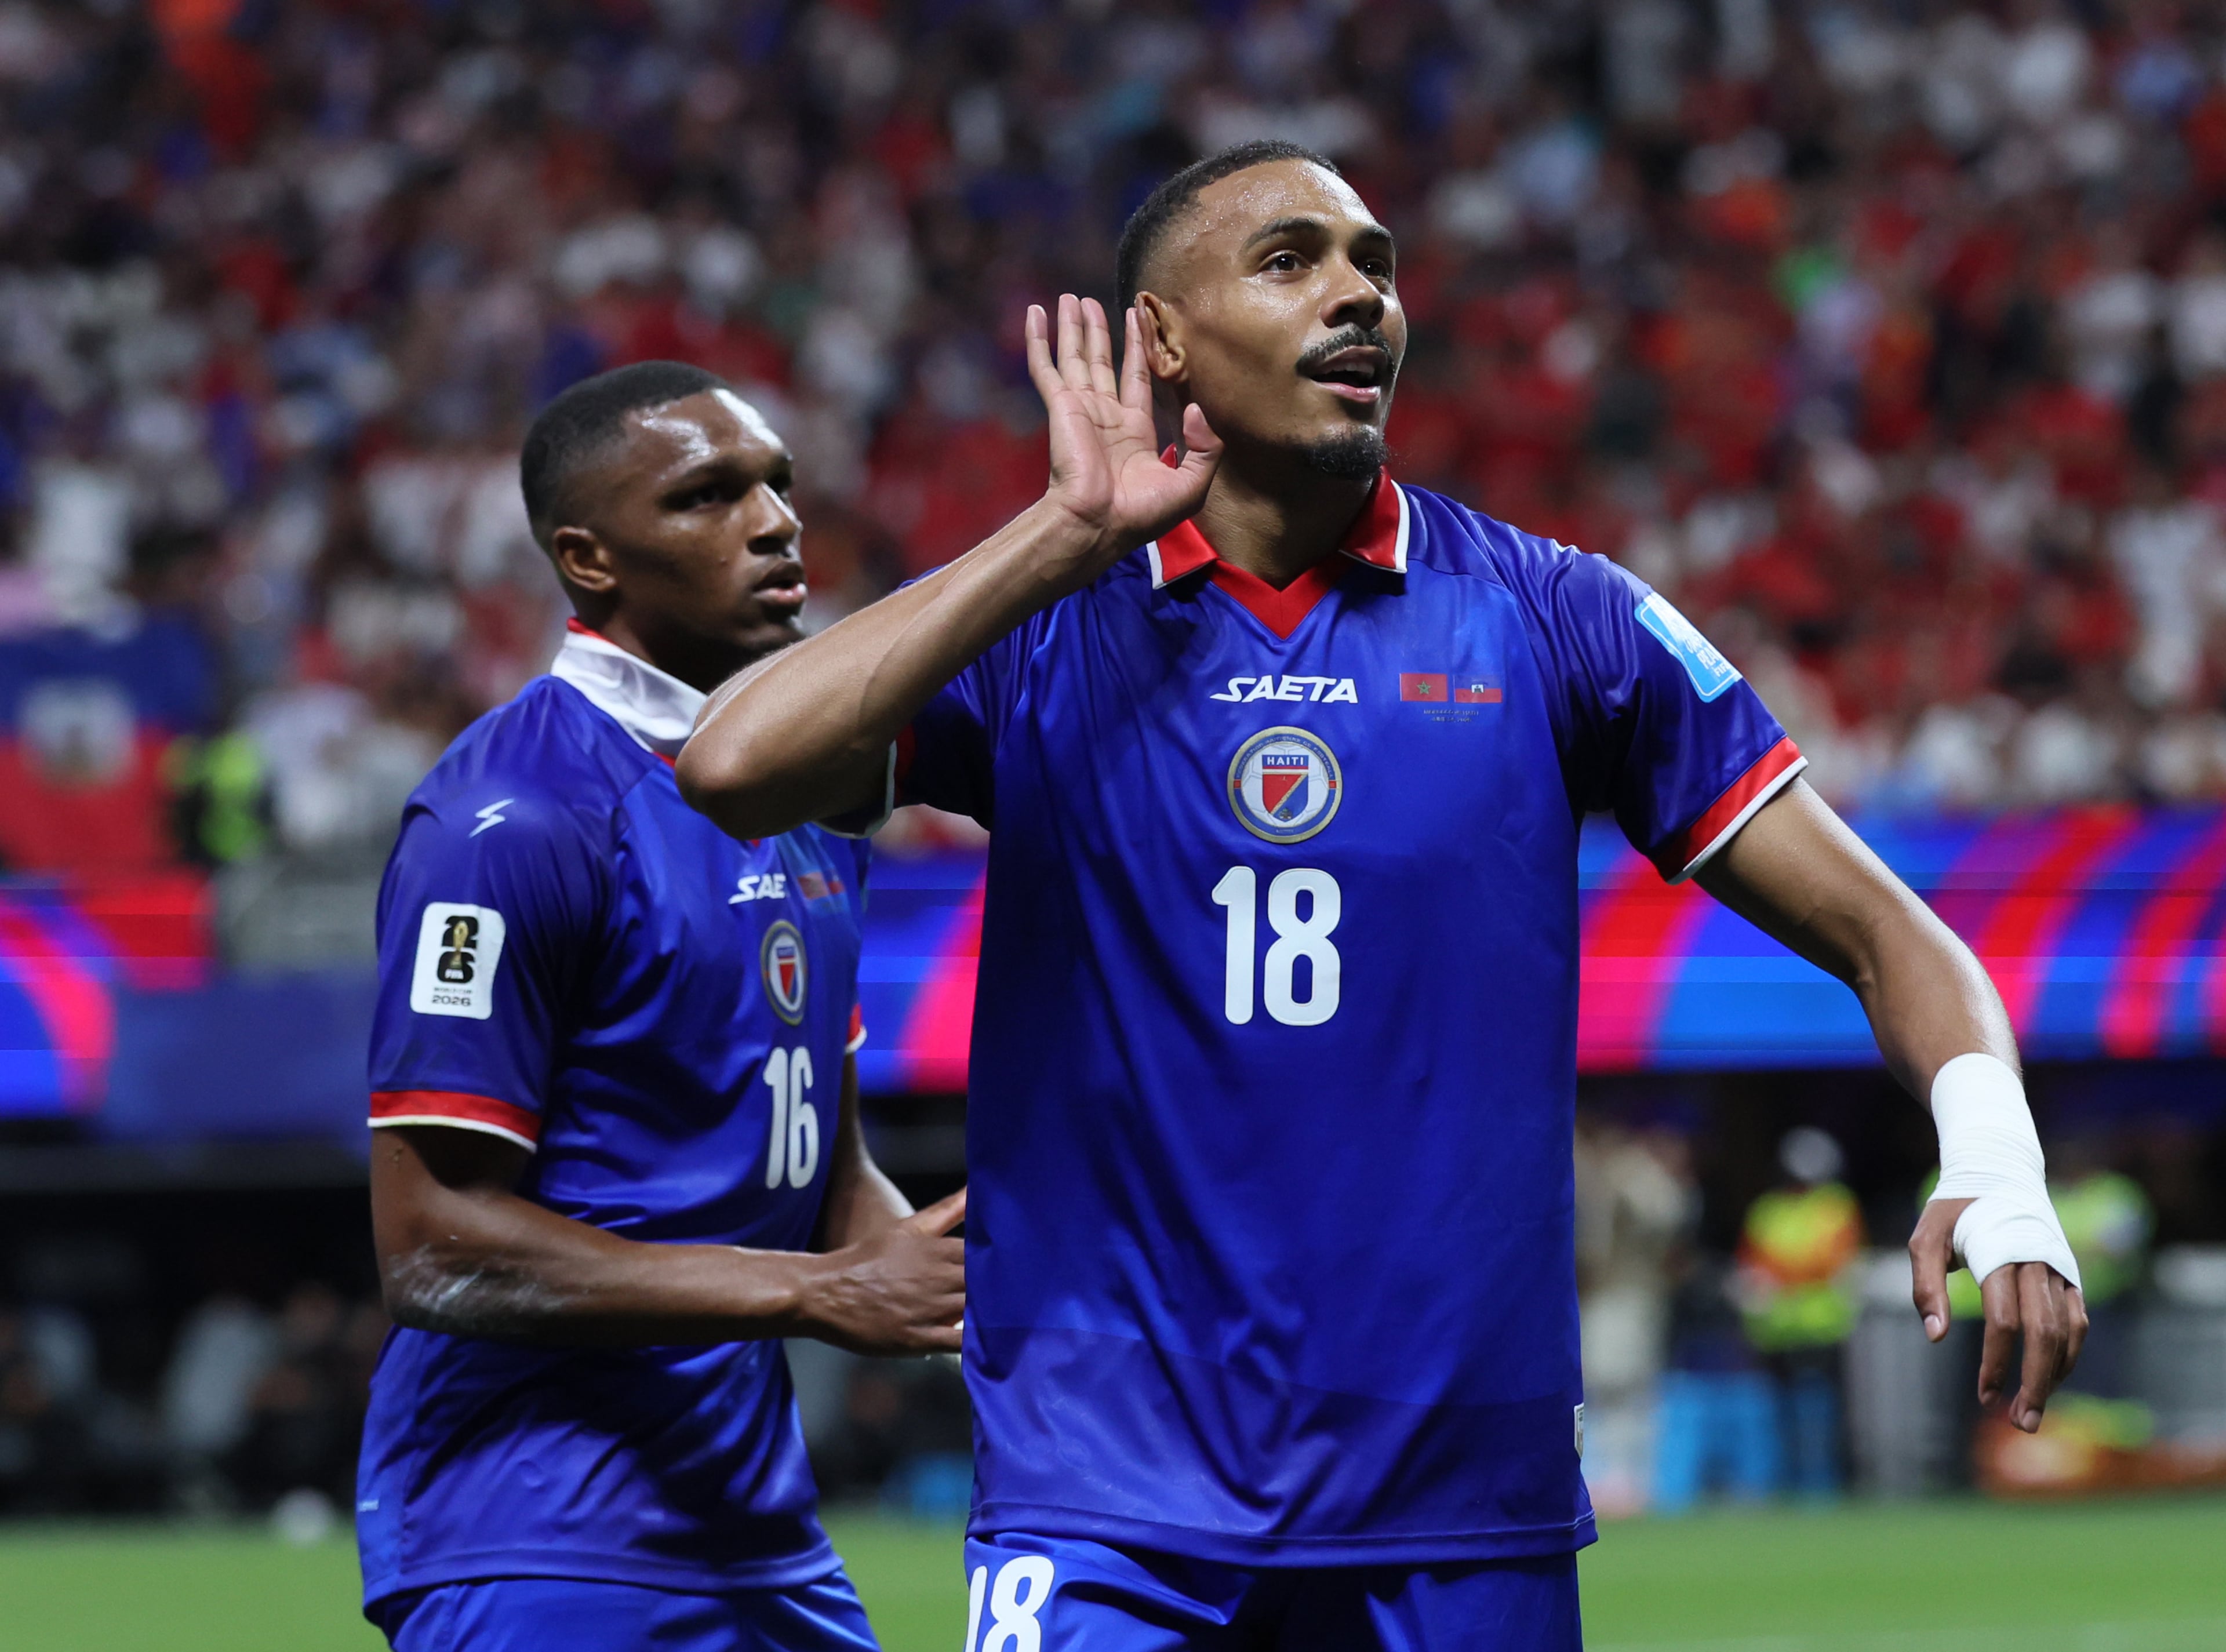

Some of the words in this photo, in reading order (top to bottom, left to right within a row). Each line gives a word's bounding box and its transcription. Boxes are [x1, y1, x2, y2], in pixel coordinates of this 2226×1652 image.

[1696, 646, 1721, 669] PLA
[1210, 675, 1358, 703] SAETA
[1267, 756, 1304, 766] HAITI
[728, 873, 787, 904] SAE
[1212, 865, 1341, 1026] 18
[432, 995, 471, 1007] 2026
[763, 1046, 819, 1189] 16
